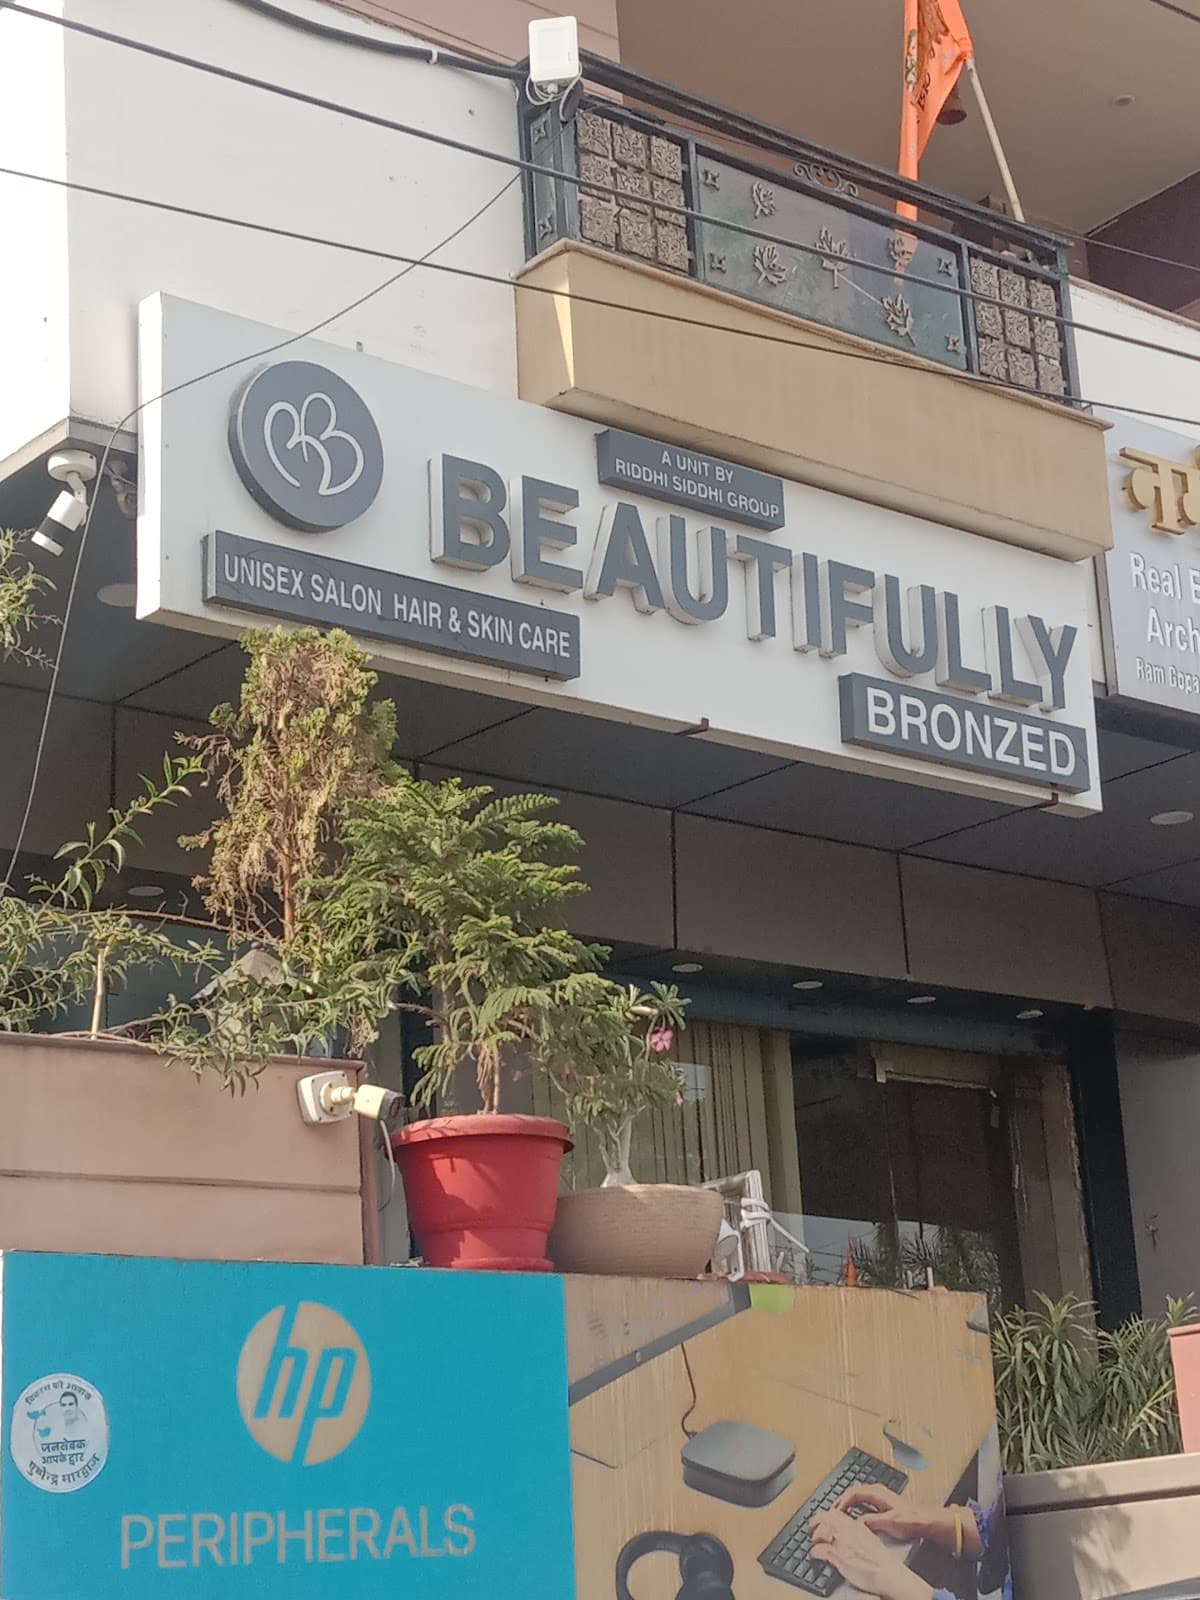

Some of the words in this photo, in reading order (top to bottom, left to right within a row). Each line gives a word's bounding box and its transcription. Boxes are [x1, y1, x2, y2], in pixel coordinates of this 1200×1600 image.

[615, 458, 668, 488] RIDDHI
[672, 475, 723, 503] SIDDHI
[726, 491, 780, 519] GROUP
[661, 451, 672, 467] A
[676, 455, 709, 478] UNIT
[715, 466, 734, 484] BY
[224, 553, 303, 599] UNISEX
[309, 573, 382, 616] SALON
[393, 596, 442, 630] HAIR
[447, 608, 463, 632] &
[467, 611, 513, 647] SKIN
[518, 622, 572, 659] CARE
[430, 453, 1078, 711] BEAUTIFULLY
[1129, 552, 1183, 601] Real
[1136, 657, 1166, 685] Ram
[865, 686, 1077, 776] BRONZED
[252, 1301, 359, 1465] hp
[121, 1504, 476, 1569] PERIPHERALS
